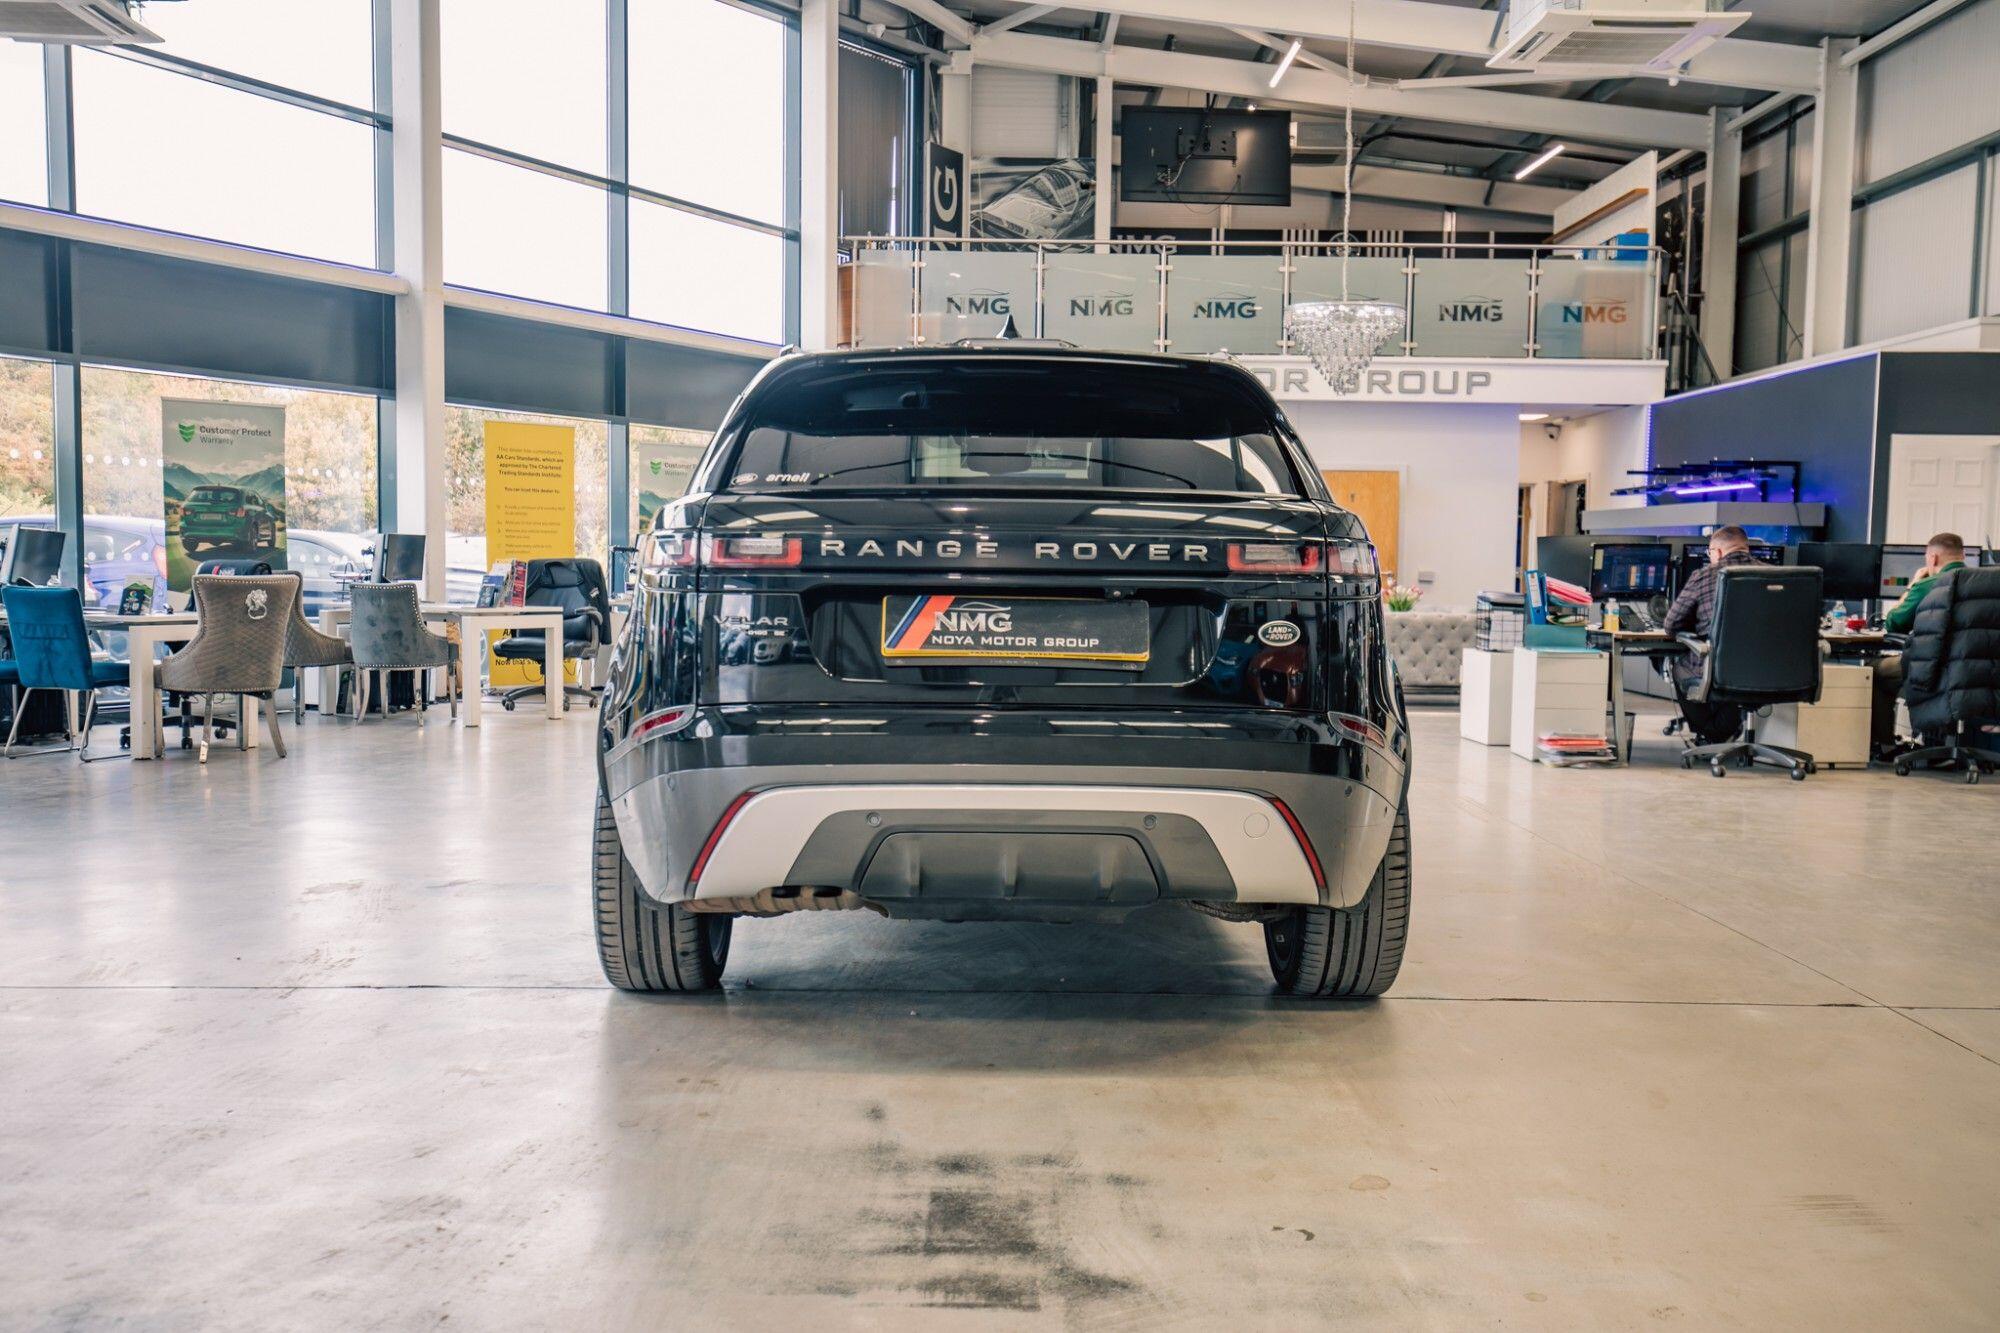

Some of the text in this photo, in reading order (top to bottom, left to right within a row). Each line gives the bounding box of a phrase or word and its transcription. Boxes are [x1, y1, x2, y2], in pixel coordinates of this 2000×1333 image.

[947, 297, 1010, 315] NMG
[1071, 299, 1134, 316] NMG
[1193, 301, 1257, 318] NMG
[1439, 304, 1504, 322] NMG
[1563, 305, 1627, 323] NMG
[200, 425, 271, 437] Customer Protect
[200, 436, 234, 446] Warranty
[820, 539, 1209, 562] RANGE ROVER
[713, 614, 789, 626] VELAR
[933, 611, 1013, 633] NMG
[1268, 626, 1288, 634] LAND
[931, 634, 1100, 648] NOYA MOTOR GROUP
